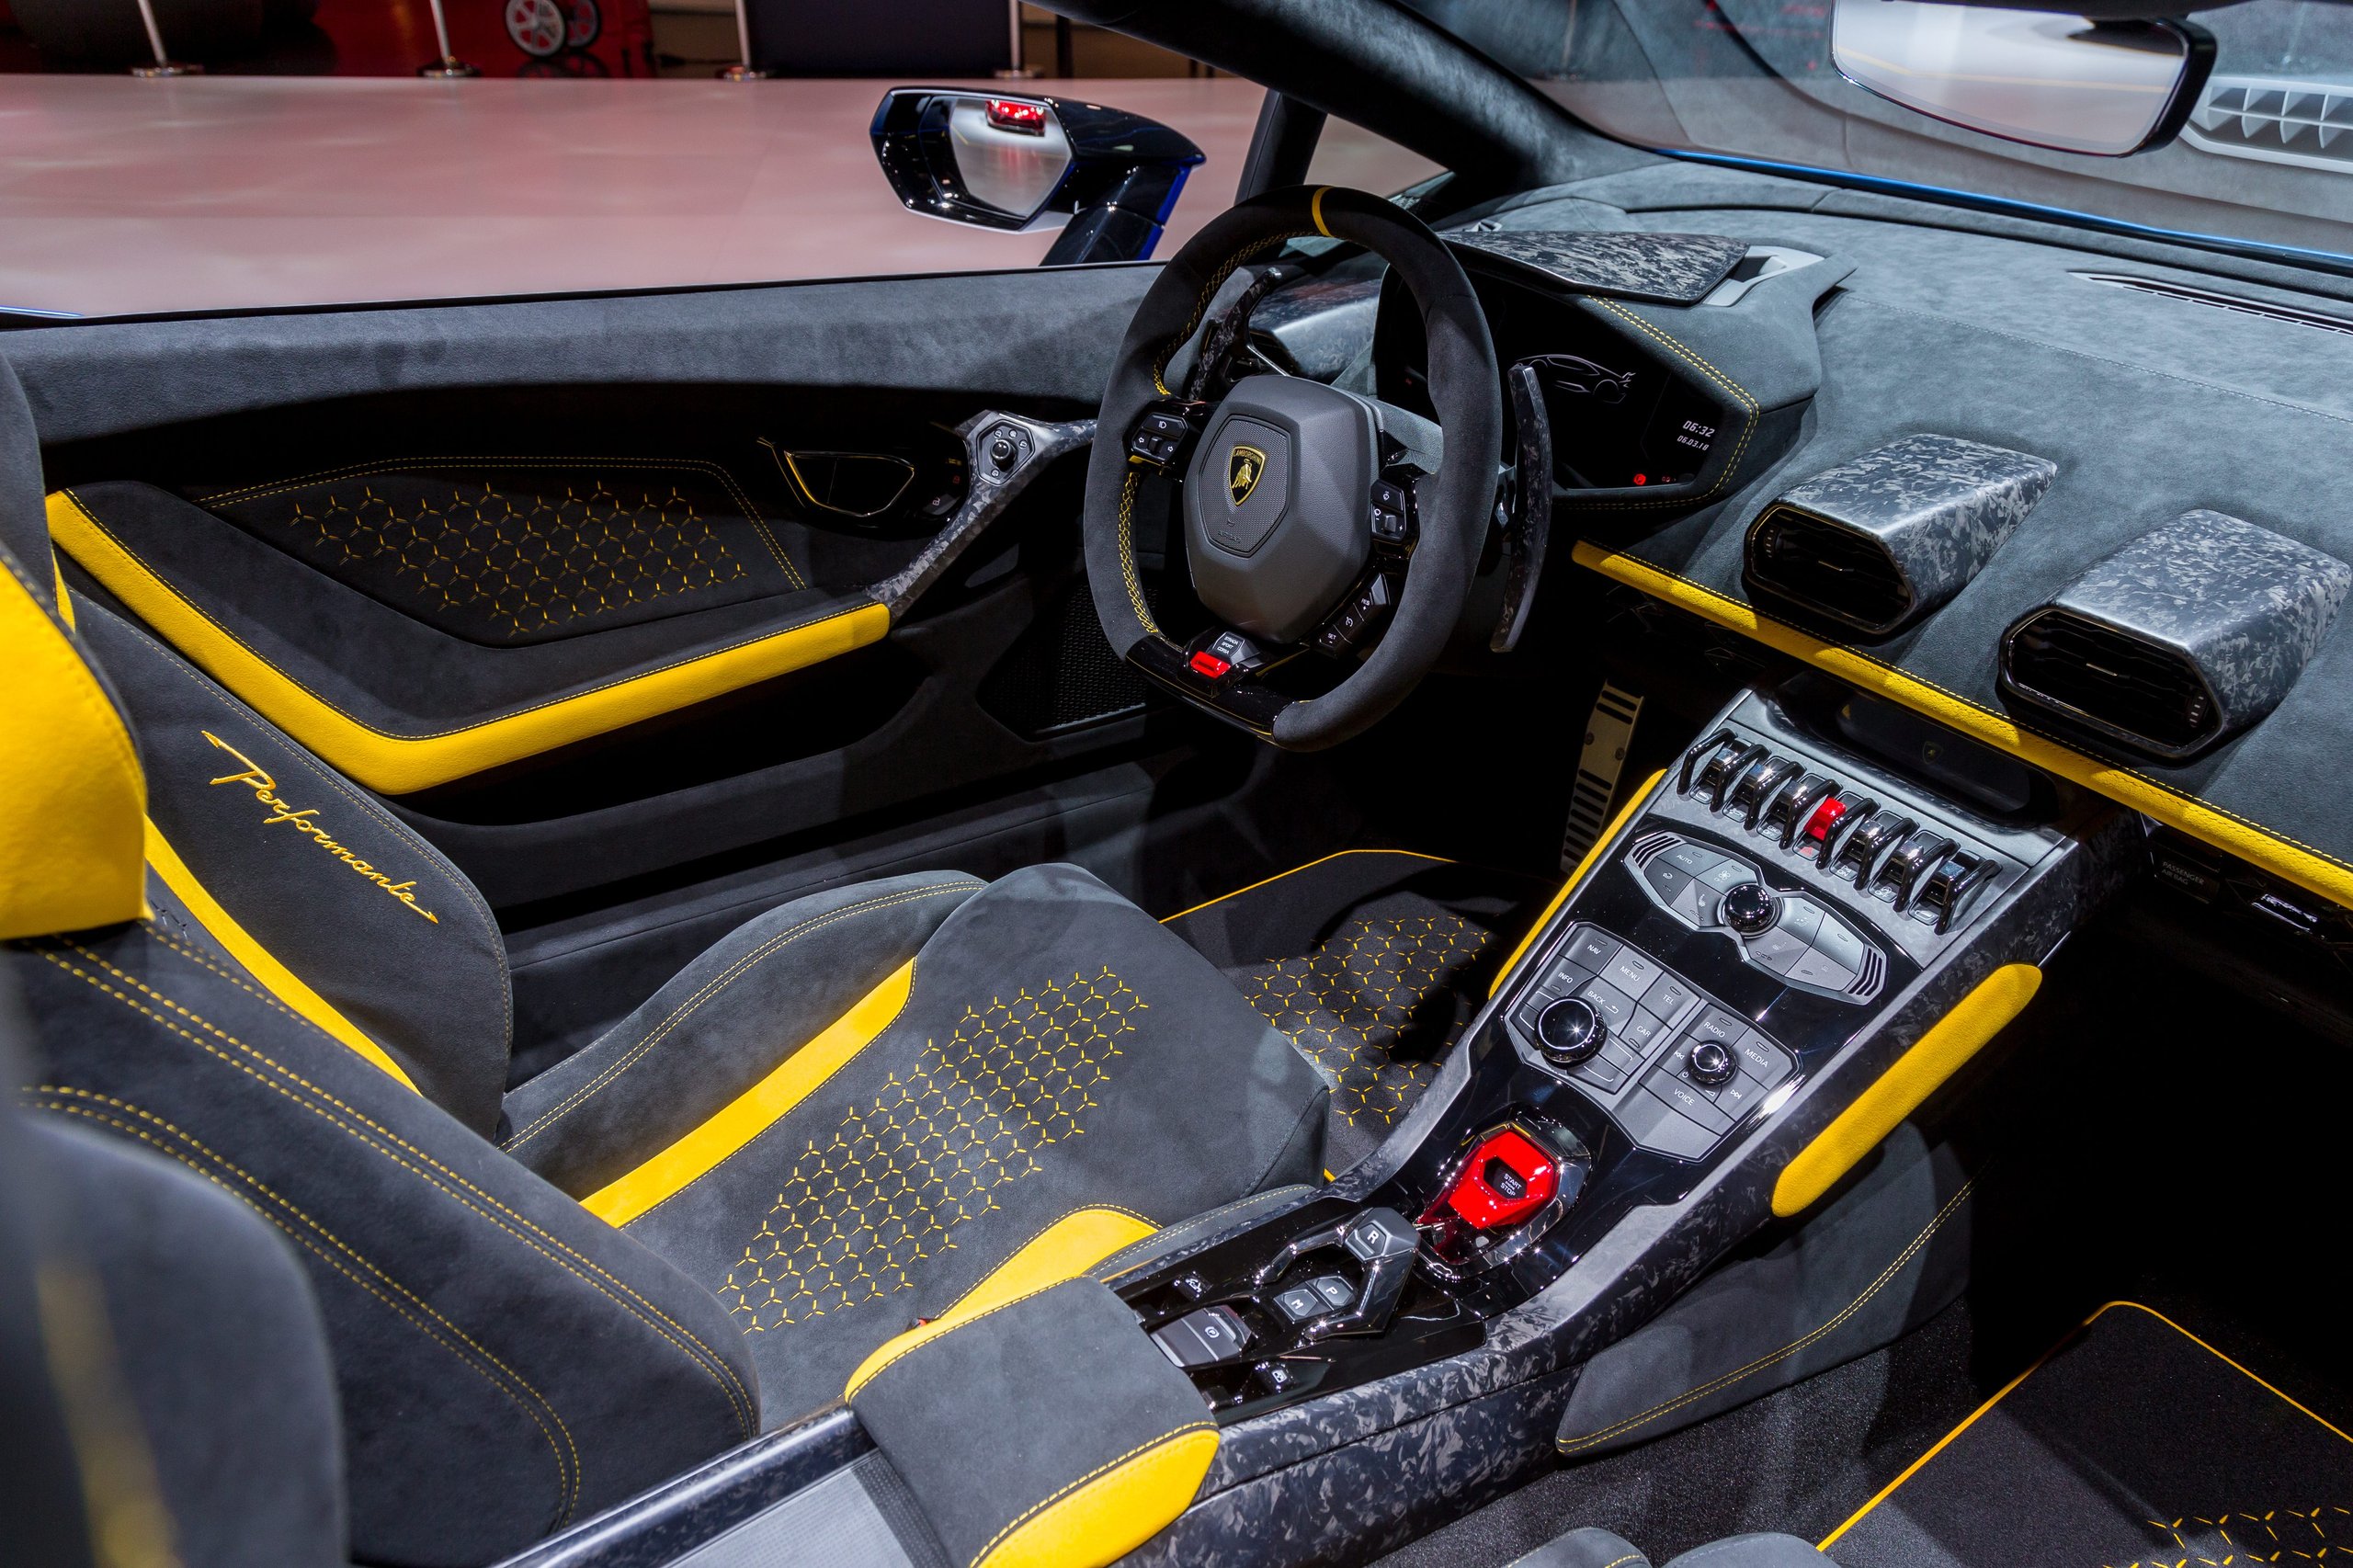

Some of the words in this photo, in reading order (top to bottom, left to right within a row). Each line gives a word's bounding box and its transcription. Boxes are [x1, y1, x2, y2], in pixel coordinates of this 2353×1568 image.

[1682, 420, 1715, 437] 06:32
[1327, 632, 1336, 641] SET
[200, 730, 439, 925] Performante
[1676, 854, 1693, 865] AUTO
[2162, 861, 2204, 885] PASSENGER
[1586, 943, 1602, 956] NAV
[1557, 971, 1574, 984] INFO
[1620, 964, 1641, 984] MENU
[1586, 990, 1606, 1006] BACK
[1662, 993, 1675, 1006] TEL
[1635, 1024, 1652, 1038] CAR
[1703, 1020, 1726, 1039] RADIO
[1744, 1048, 1769, 1069] MEDIA
[1673, 1087, 1696, 1106] VOICE
[1504, 1173, 1522, 1189] START
[1500, 1183, 1516, 1196] STOP
[1366, 1231, 1380, 1244] R
[1324, 1285, 1338, 1299] P
[1290, 1298, 1304, 1311] M
